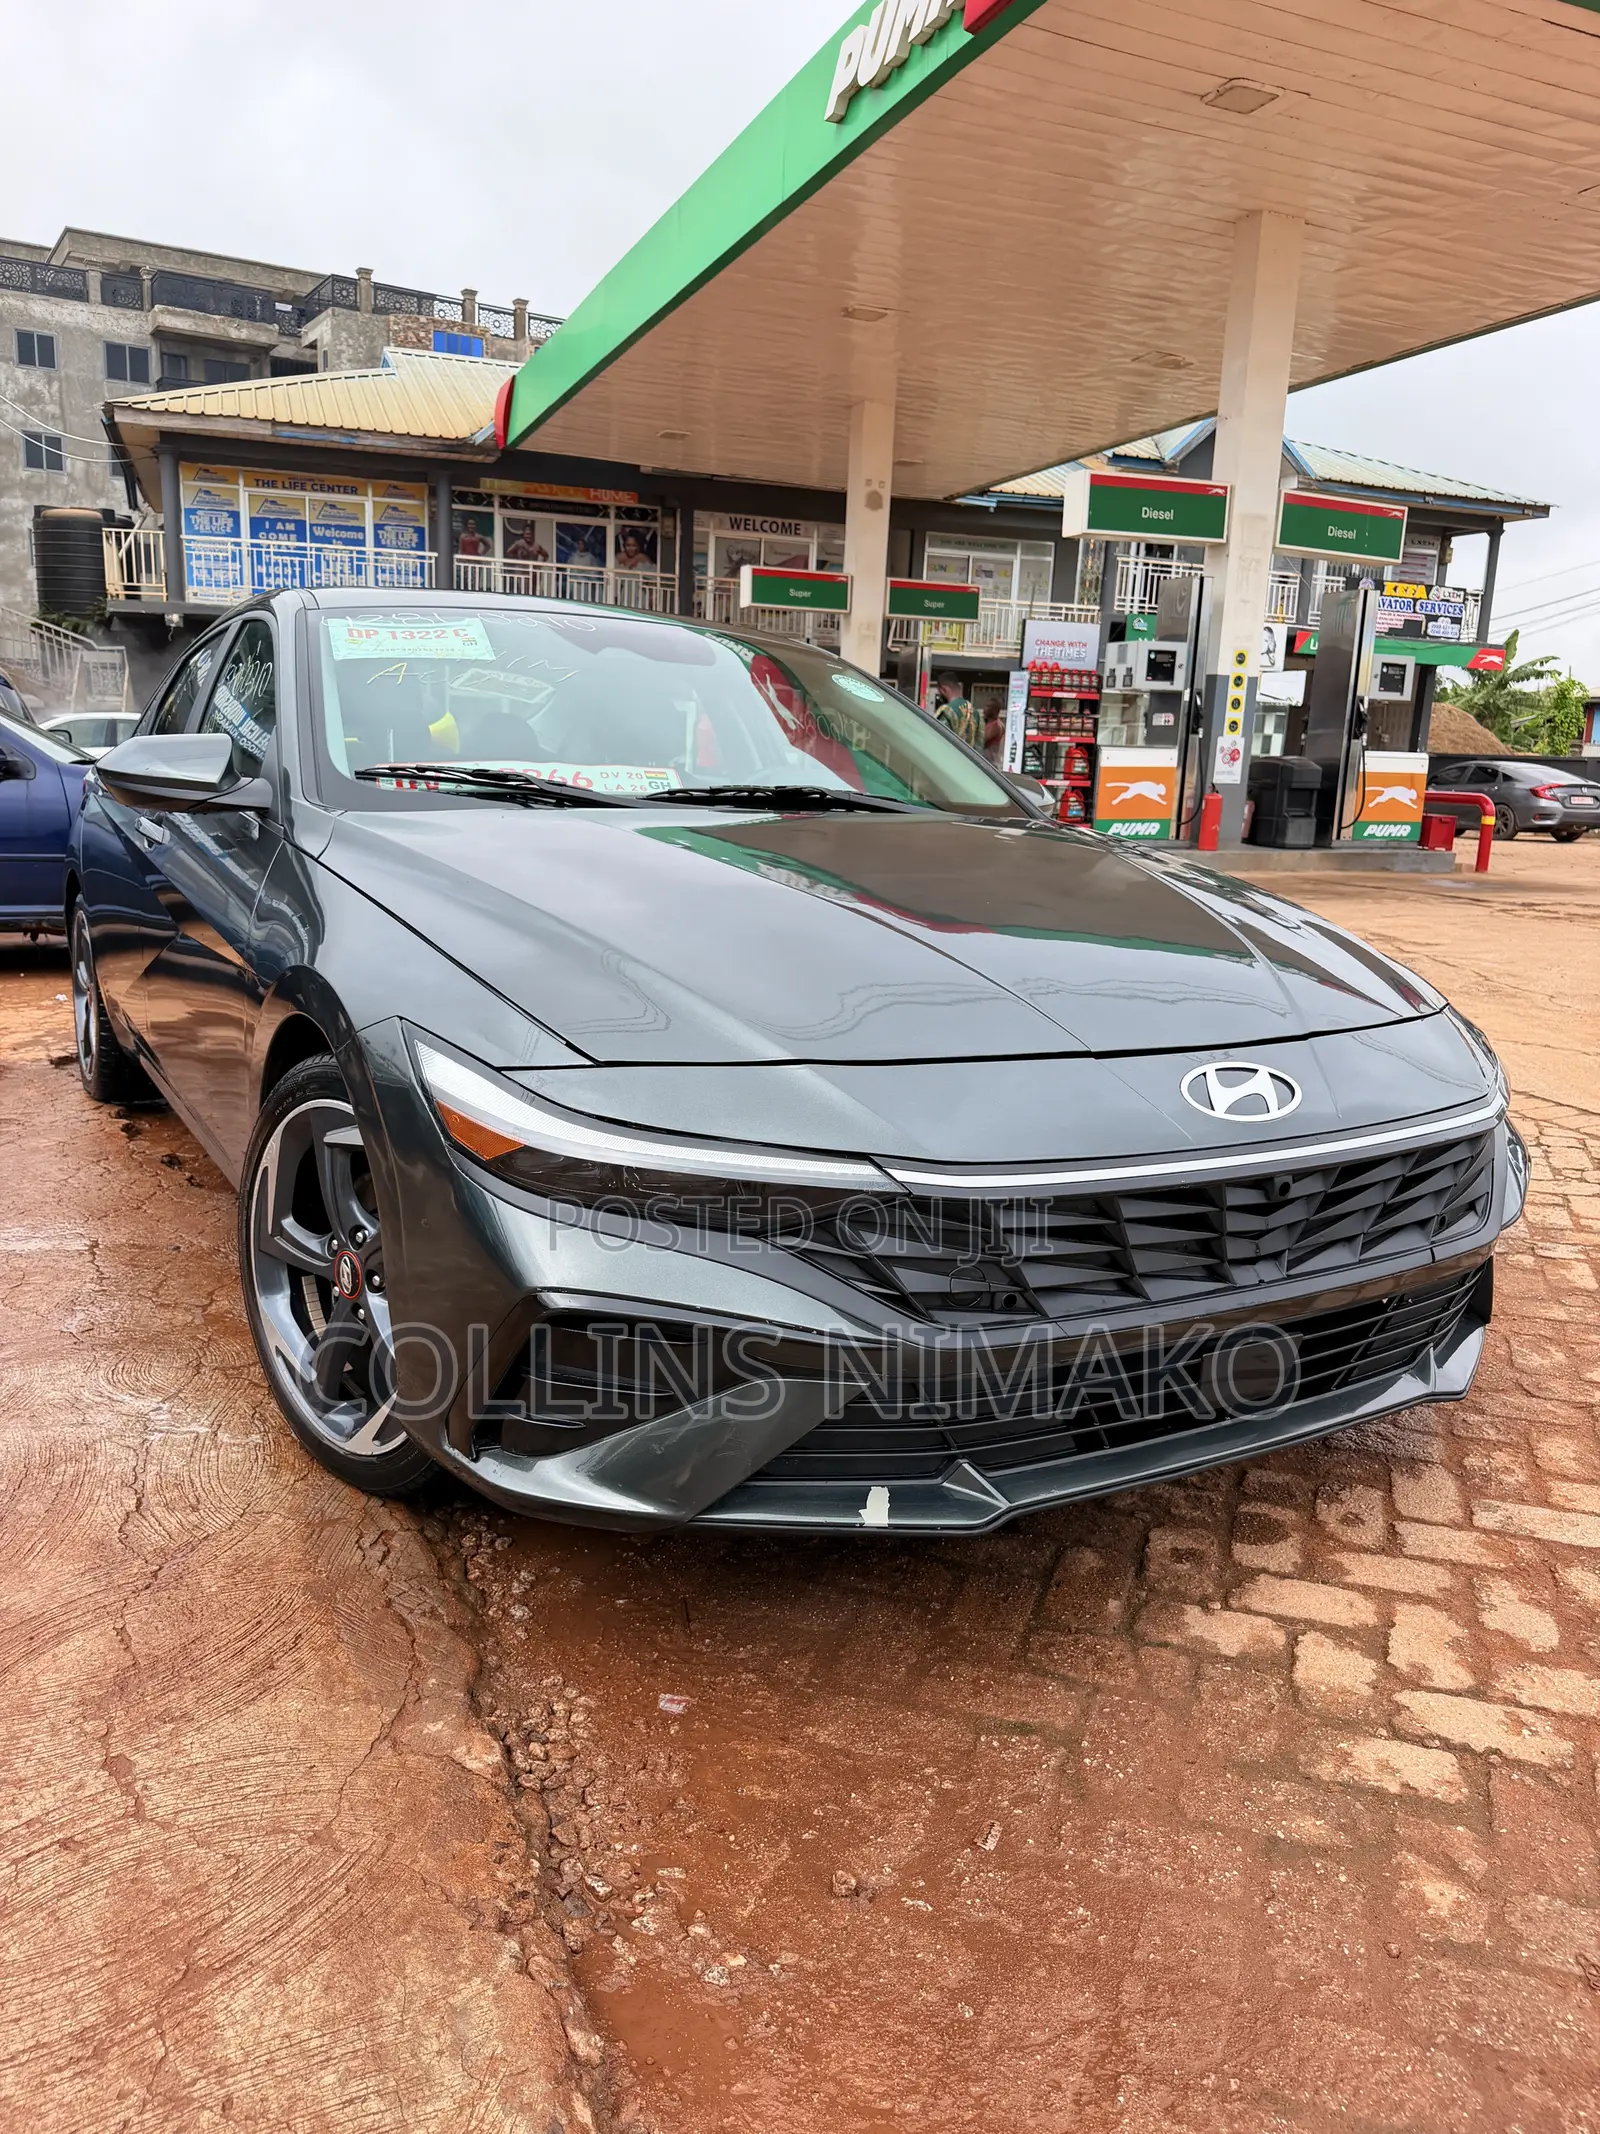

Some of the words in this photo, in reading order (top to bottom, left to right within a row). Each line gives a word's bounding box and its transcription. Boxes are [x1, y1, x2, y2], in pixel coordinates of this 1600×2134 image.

[824, 0, 966, 123] PUM
[253, 478, 279, 488] THE
[281, 480, 307, 491] LIFE
[310, 482, 358, 495] CENTER
[1141, 507, 1174, 521] Diesel
[275, 521, 296, 531] AM
[728, 516, 802, 536] WELCOME
[1327, 525, 1357, 540] Diesel
[312, 526, 365, 540] Welcome
[788, 587, 812, 599] Super
[923, 599, 946, 609] Super
[1379, 597, 1413, 611] VATOR
[1418, 600, 1464, 616] SERVICES
[347, 628, 380, 640] DP
[387, 629, 449, 641] 1322
[1035, 638, 1066, 648] CHANGE
[1067, 640, 1088, 649] WITH
[1035, 647, 1054, 656] THE
[1056, 648, 1087, 658] TIMES
[600, 771, 620, 779] DV
[626, 772, 643, 780] 20
[630, 784, 648, 792] 26
[648, 780, 672, 791] GH
[1107, 822, 1161, 836] PUMA
[1362, 824, 1412, 837] PUMA
